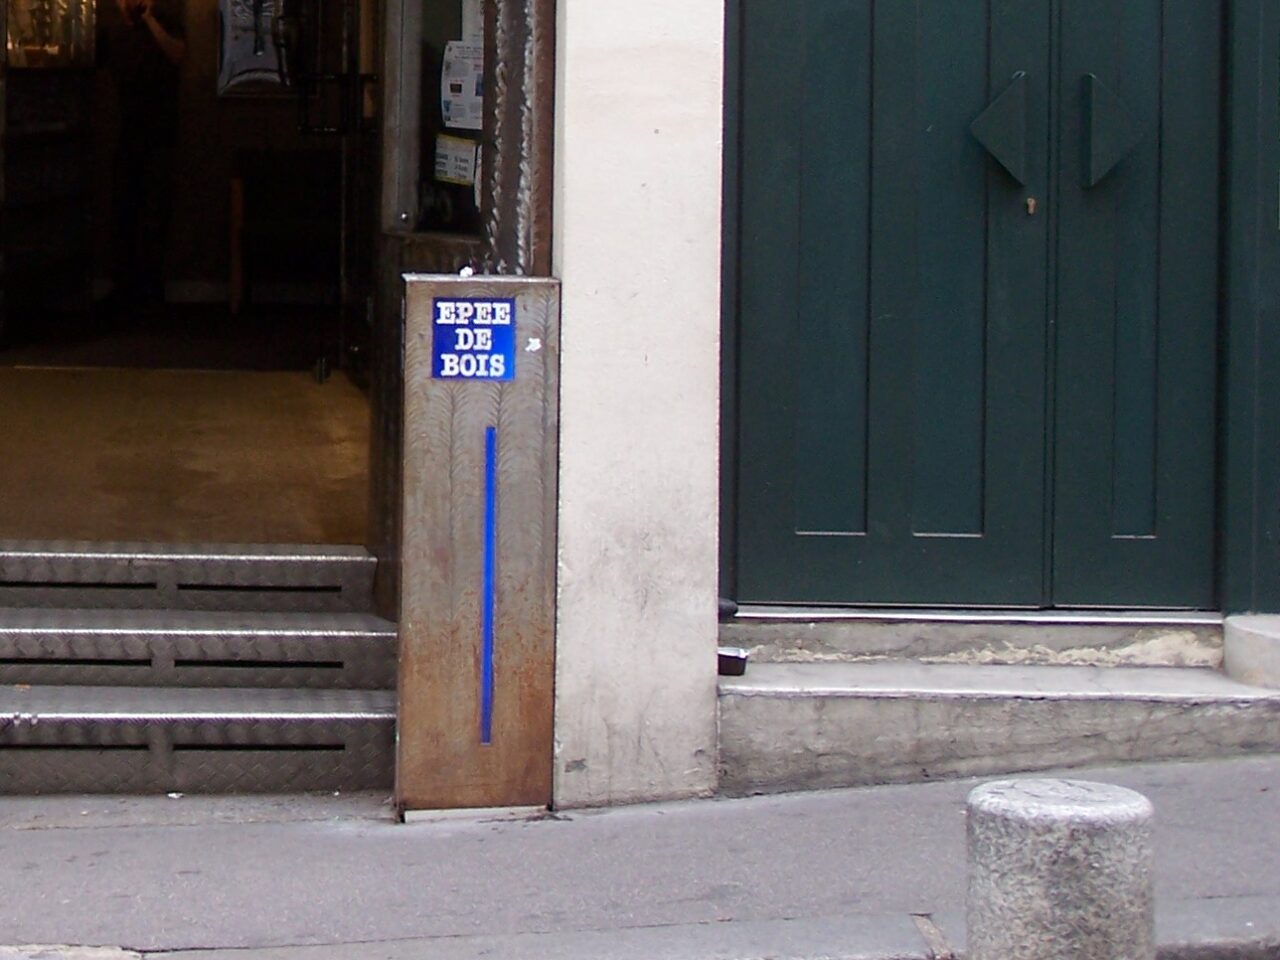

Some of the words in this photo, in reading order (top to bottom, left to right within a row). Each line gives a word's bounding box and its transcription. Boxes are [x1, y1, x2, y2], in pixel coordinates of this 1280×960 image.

[436, 301, 511, 325] EPEE
[454, 327, 493, 351] DE
[440, 353, 506, 377] BOIS
